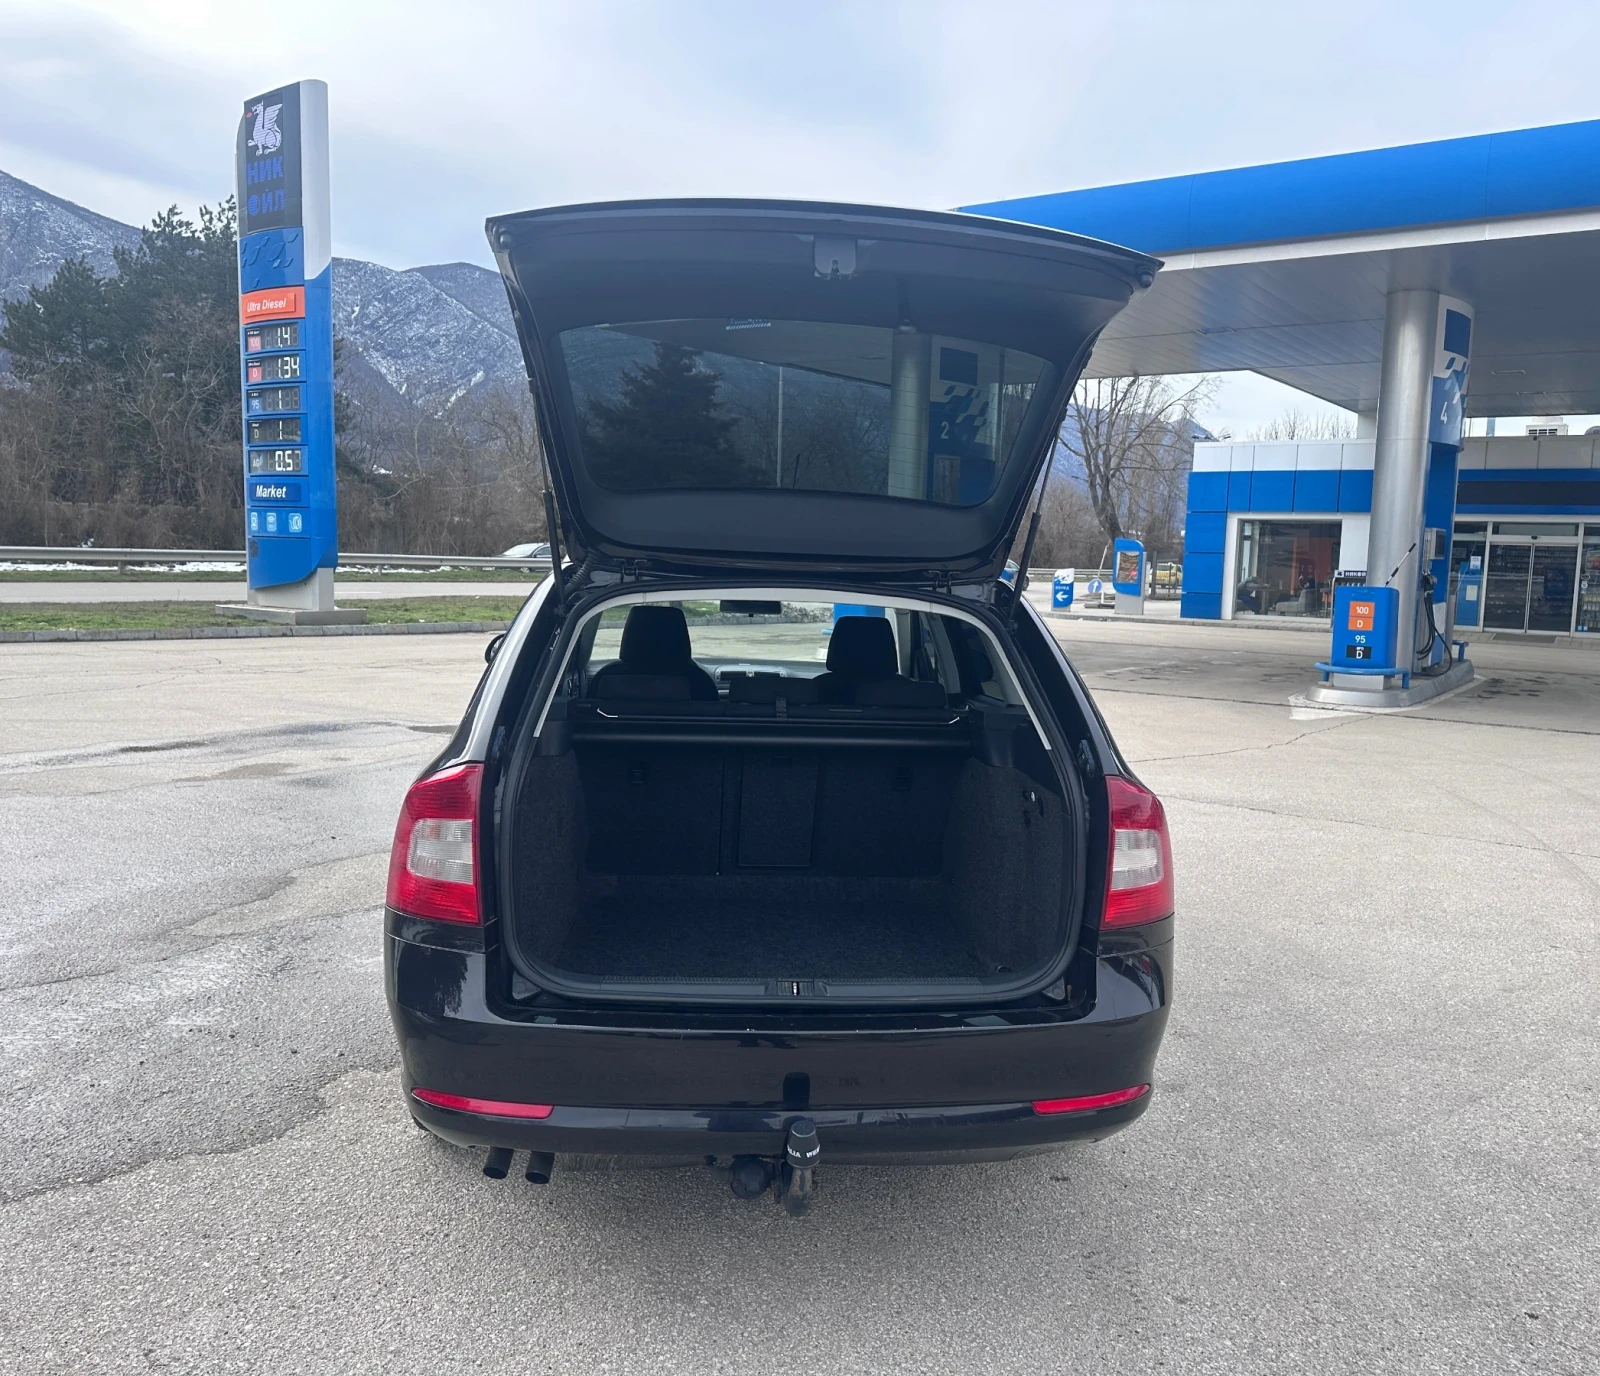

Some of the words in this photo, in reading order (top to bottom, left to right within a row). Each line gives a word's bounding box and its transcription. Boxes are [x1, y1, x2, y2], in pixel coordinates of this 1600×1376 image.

[247, 155, 284, 185] НИК
[246, 301, 261, 313] Ultra
[262, 298, 287, 310] Diesel
[251, 399, 260, 409] 95
[1440, 401, 1448, 425] 4
[940, 421, 949, 440] 2
[256, 485, 286, 498] Market
[1355, 606, 1369, 615] 100
[1357, 620, 1363, 628] D
[1355, 635, 1366, 644] 95
[1356, 651, 1363, 659] D
